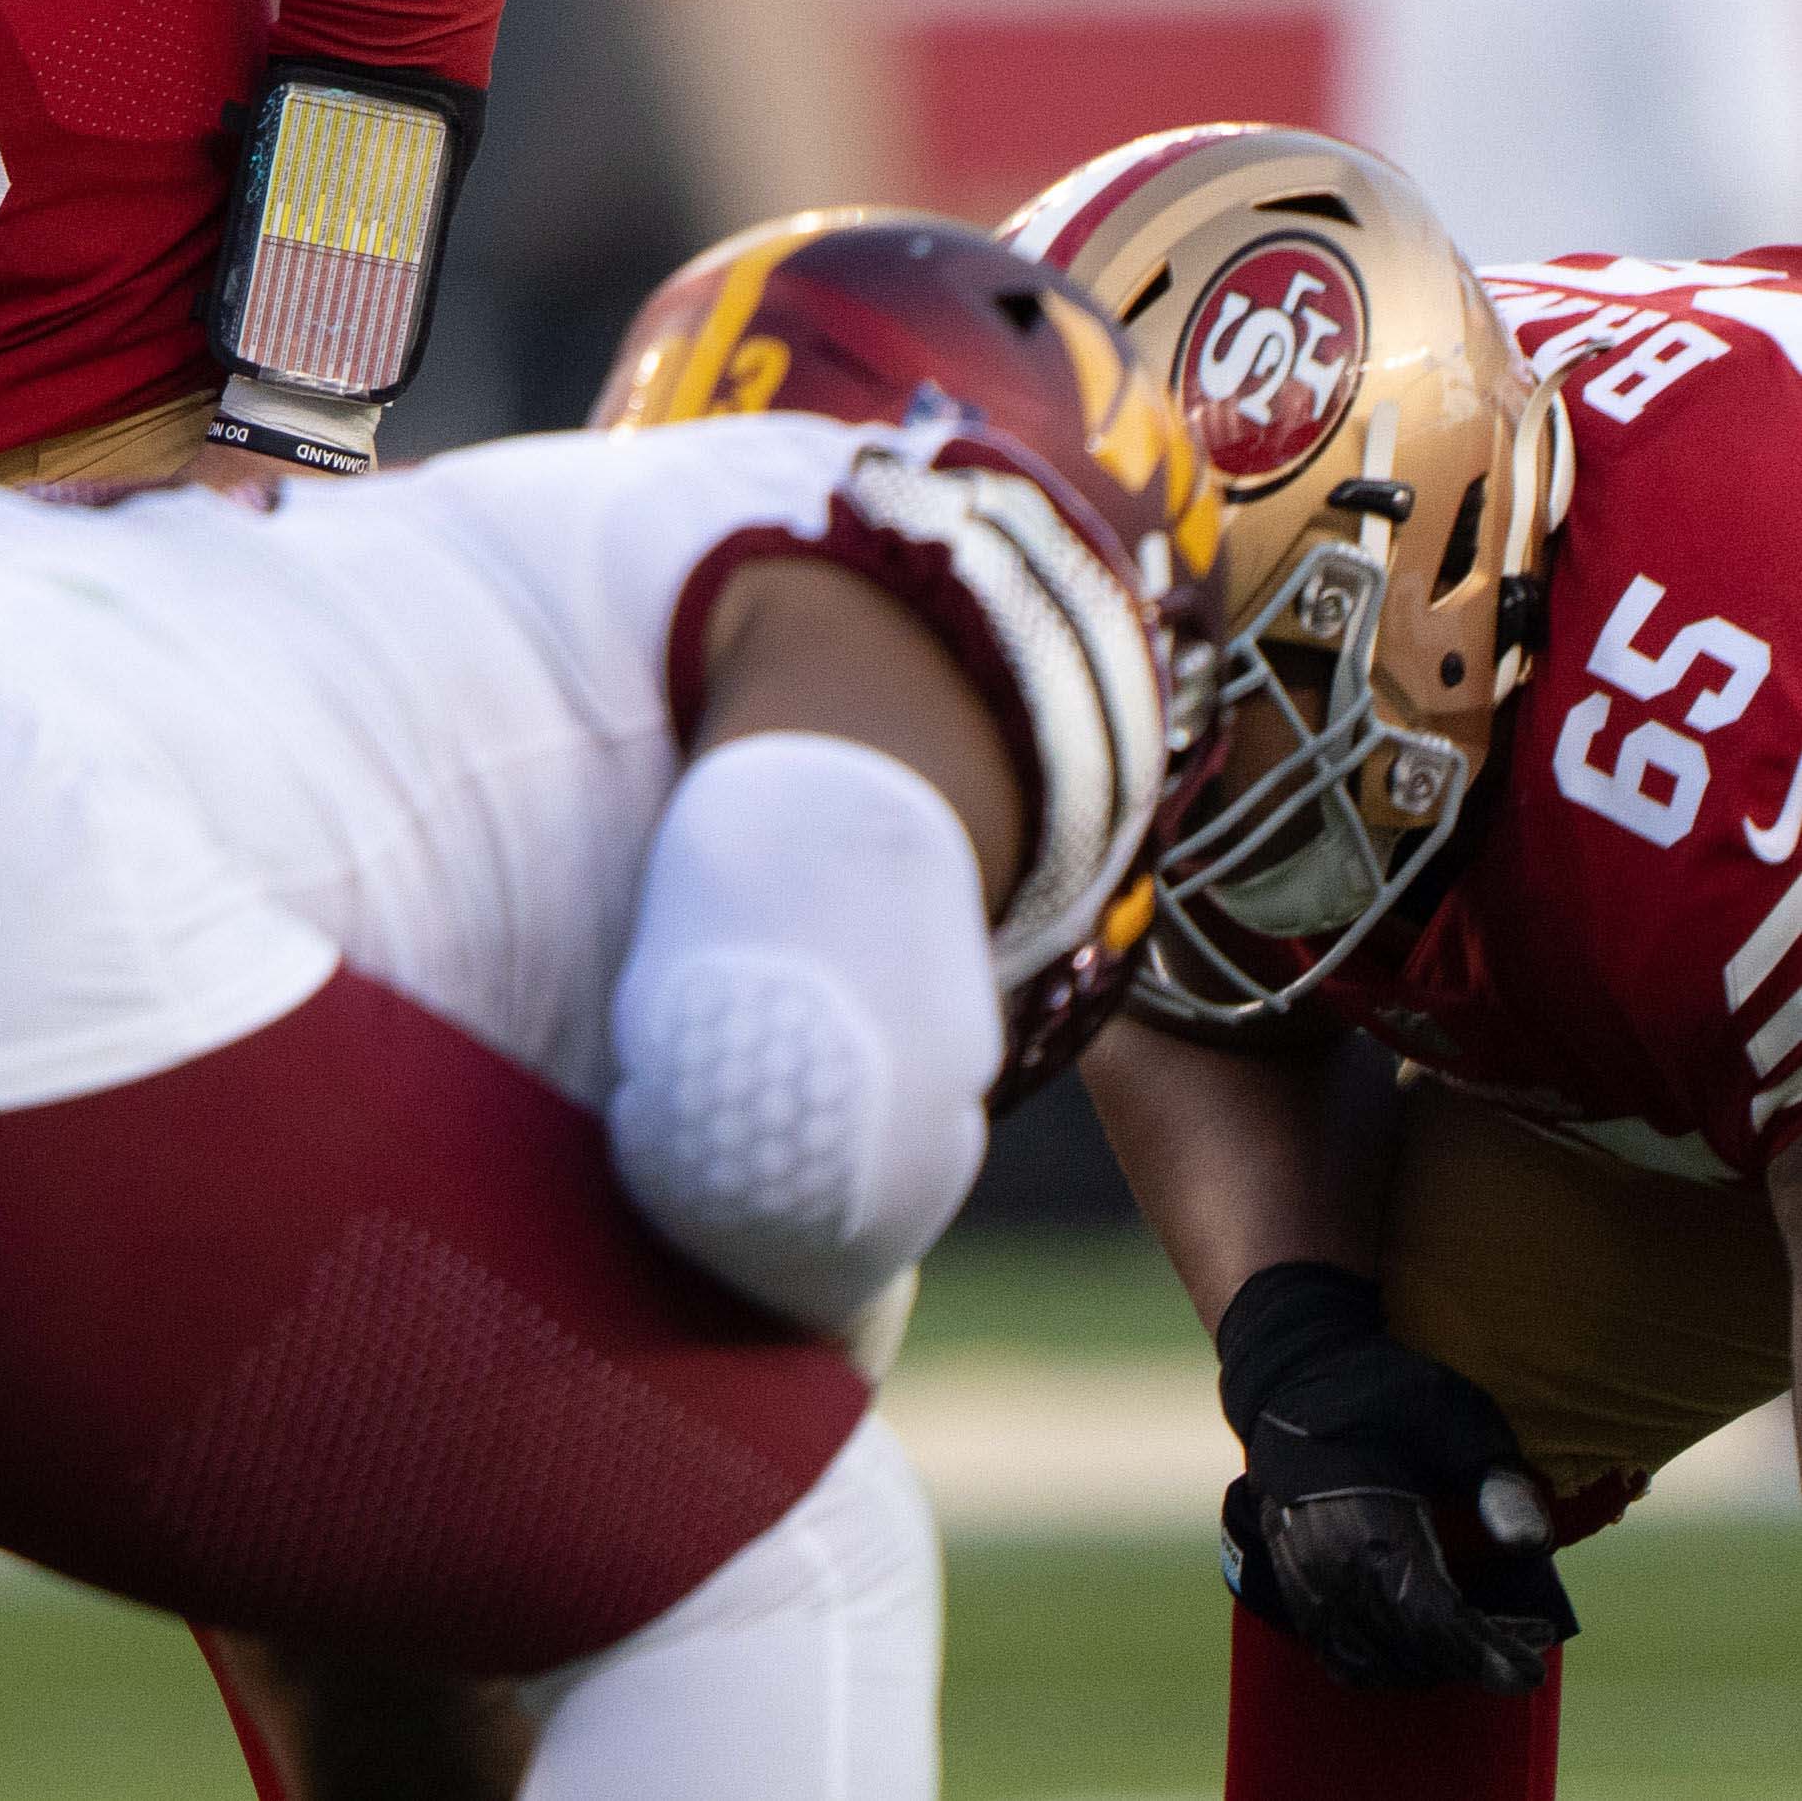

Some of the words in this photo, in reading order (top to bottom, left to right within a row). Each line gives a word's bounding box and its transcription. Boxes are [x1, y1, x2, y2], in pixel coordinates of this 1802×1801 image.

[1199, 271, 1346, 425] SF
[226, 425, 249, 442] DO
[1553, 573, 1772, 849] 65
